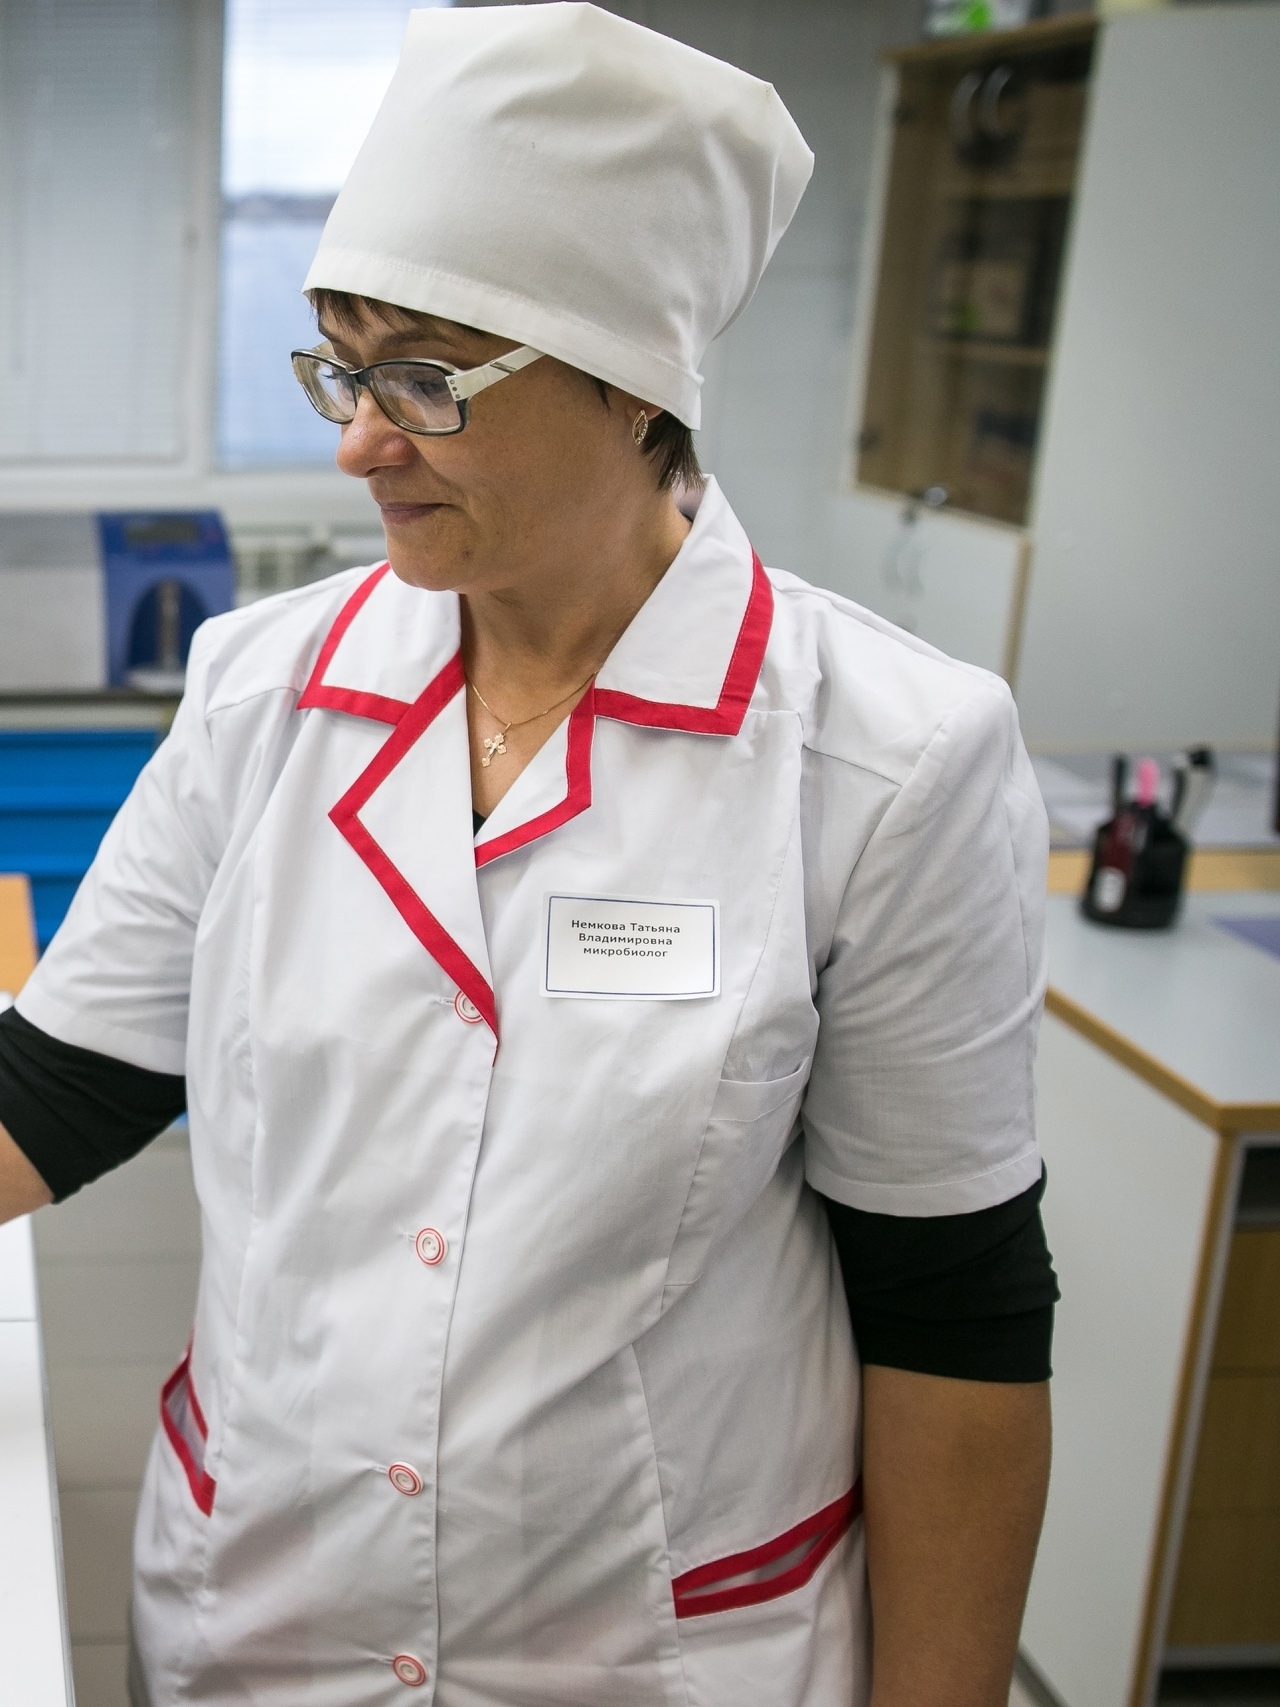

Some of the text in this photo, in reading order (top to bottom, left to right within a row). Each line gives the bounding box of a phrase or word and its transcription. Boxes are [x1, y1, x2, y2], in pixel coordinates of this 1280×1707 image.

[571, 920, 680, 933] Немкова Татьяна
[579, 933, 672, 945] Владимировна
[583, 947, 668, 957] микробиолог
